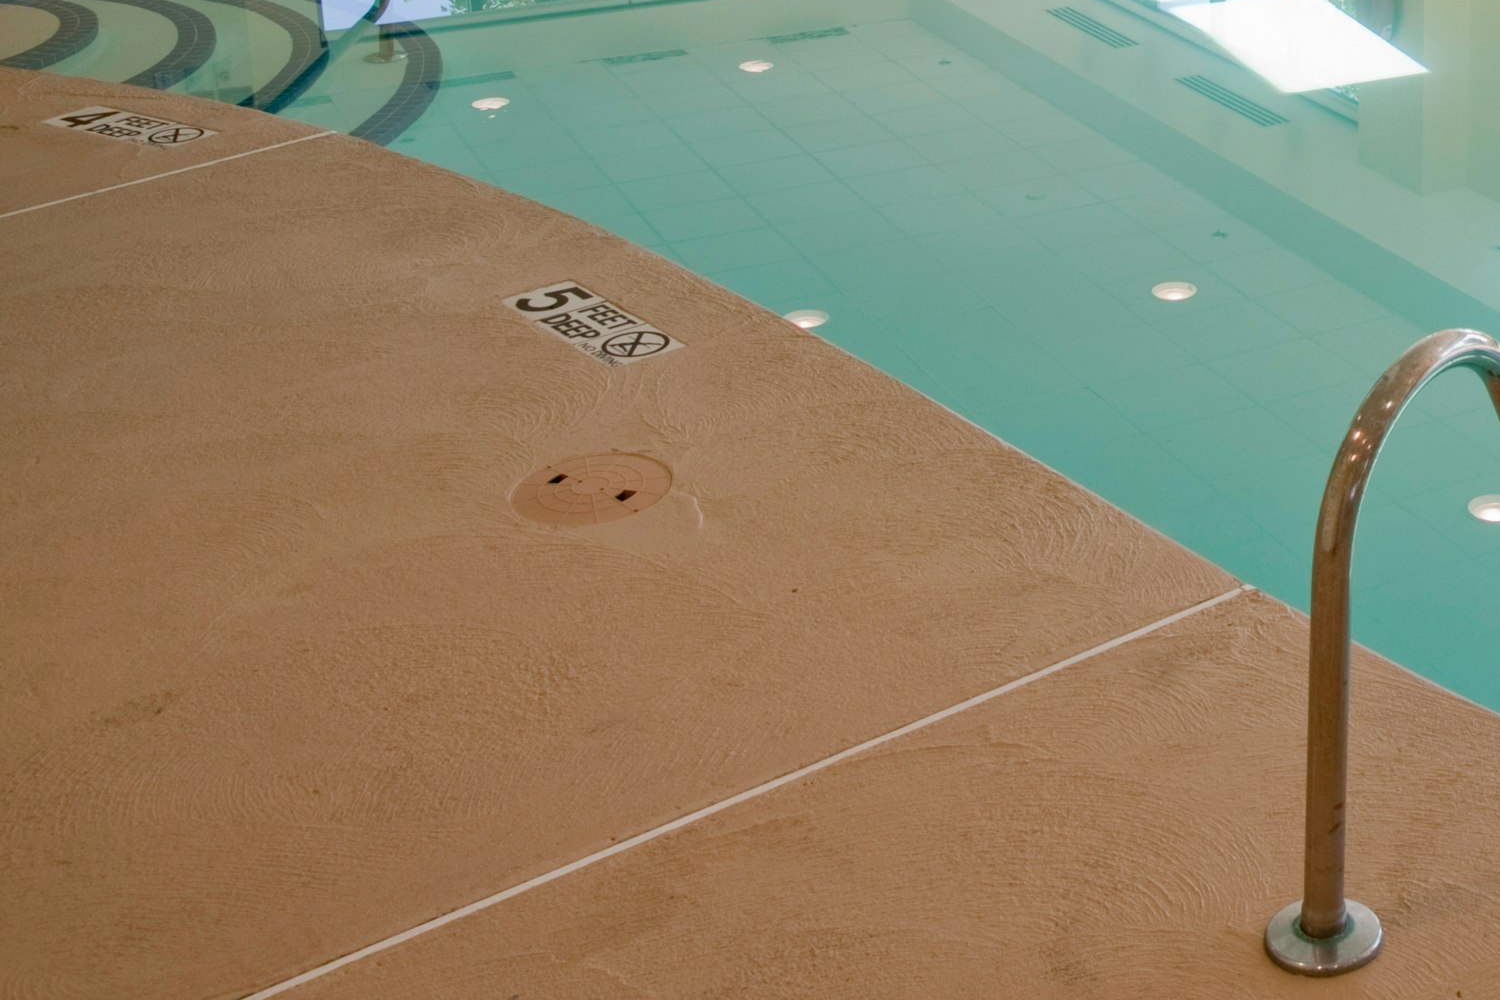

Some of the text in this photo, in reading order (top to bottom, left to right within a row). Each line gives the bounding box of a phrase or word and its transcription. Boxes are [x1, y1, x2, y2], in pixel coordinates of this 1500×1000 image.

[59, 111, 171, 130] 4 FEET
[86, 123, 142, 138] DEEP
[515, 287, 638, 330] 5 FEET
[539, 312, 601, 339] DEEP
